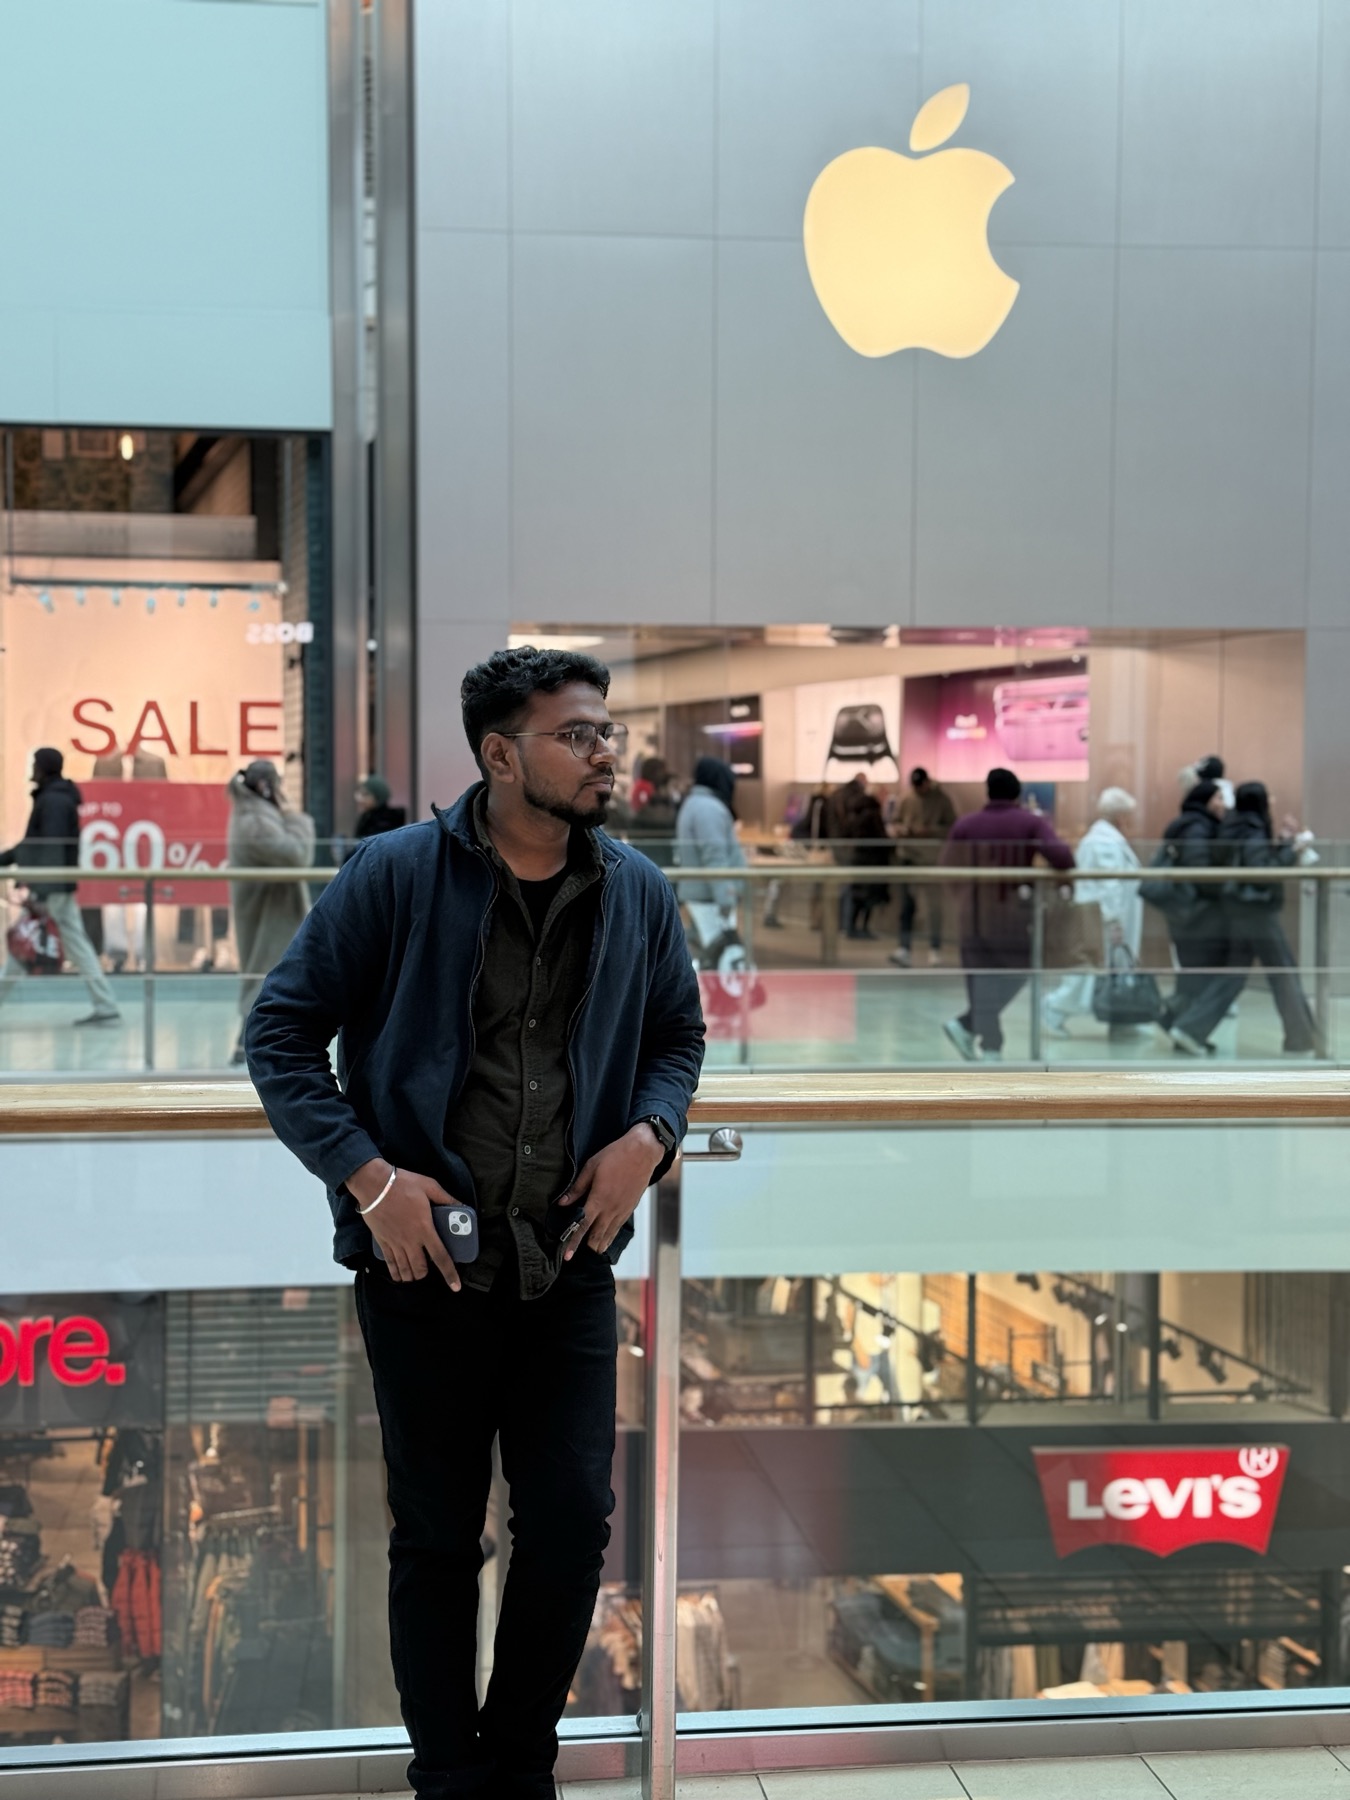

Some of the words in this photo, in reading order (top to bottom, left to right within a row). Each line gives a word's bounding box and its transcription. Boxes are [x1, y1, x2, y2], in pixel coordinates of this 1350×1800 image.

[70, 698, 283, 757] SALE
[101, 802, 123, 817] TO
[0, 1315, 126, 1387] re.
